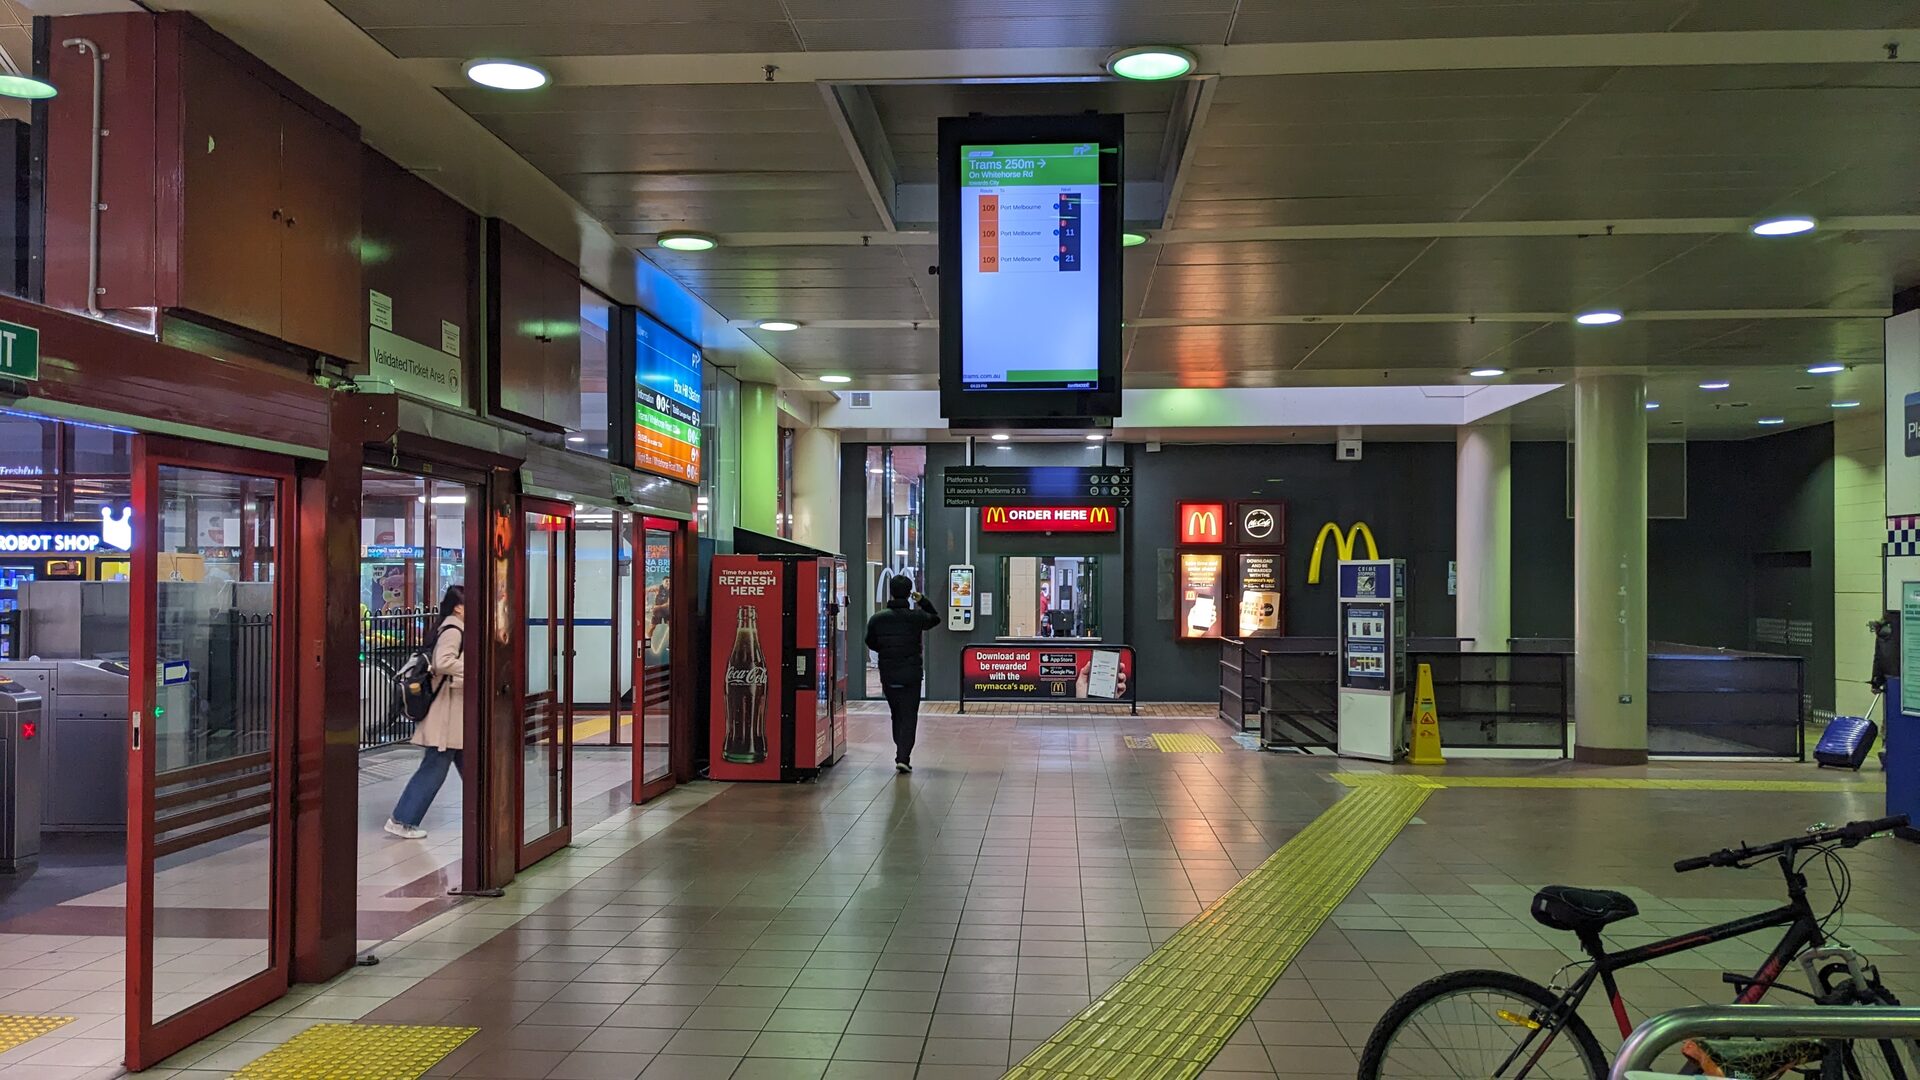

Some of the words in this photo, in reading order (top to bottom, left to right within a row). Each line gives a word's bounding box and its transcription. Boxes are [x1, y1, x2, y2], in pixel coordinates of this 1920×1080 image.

[969, 159, 1002, 170] Trams
[1005, 159, 1035, 170] 250m
[969, 171, 980, 179] On
[981, 170, 1021, 178] Whitehorse
[1023, 170, 1033, 178] Rd
[373, 347, 408, 372] Validated
[408, 360, 429, 379] Ticket
[430, 368, 445, 384] Area
[1909, 422, 1920, 440] Pl
[1009, 510, 1051, 520] ORDER
[1054, 510, 1087, 520] HERE
[54, 535, 100, 551] SHOP
[719, 576, 776, 585] REFRESH
[731, 586, 765, 595] HERE
[976, 652, 1015, 660] Download
[1016, 652, 1030, 660] and
[980, 662, 990, 670] be
[991, 662, 1027, 670] rewarded
[989, 672, 1005, 680] with
[1007, 672, 1020, 680] the
[975, 683, 1018, 691] mymacca's
